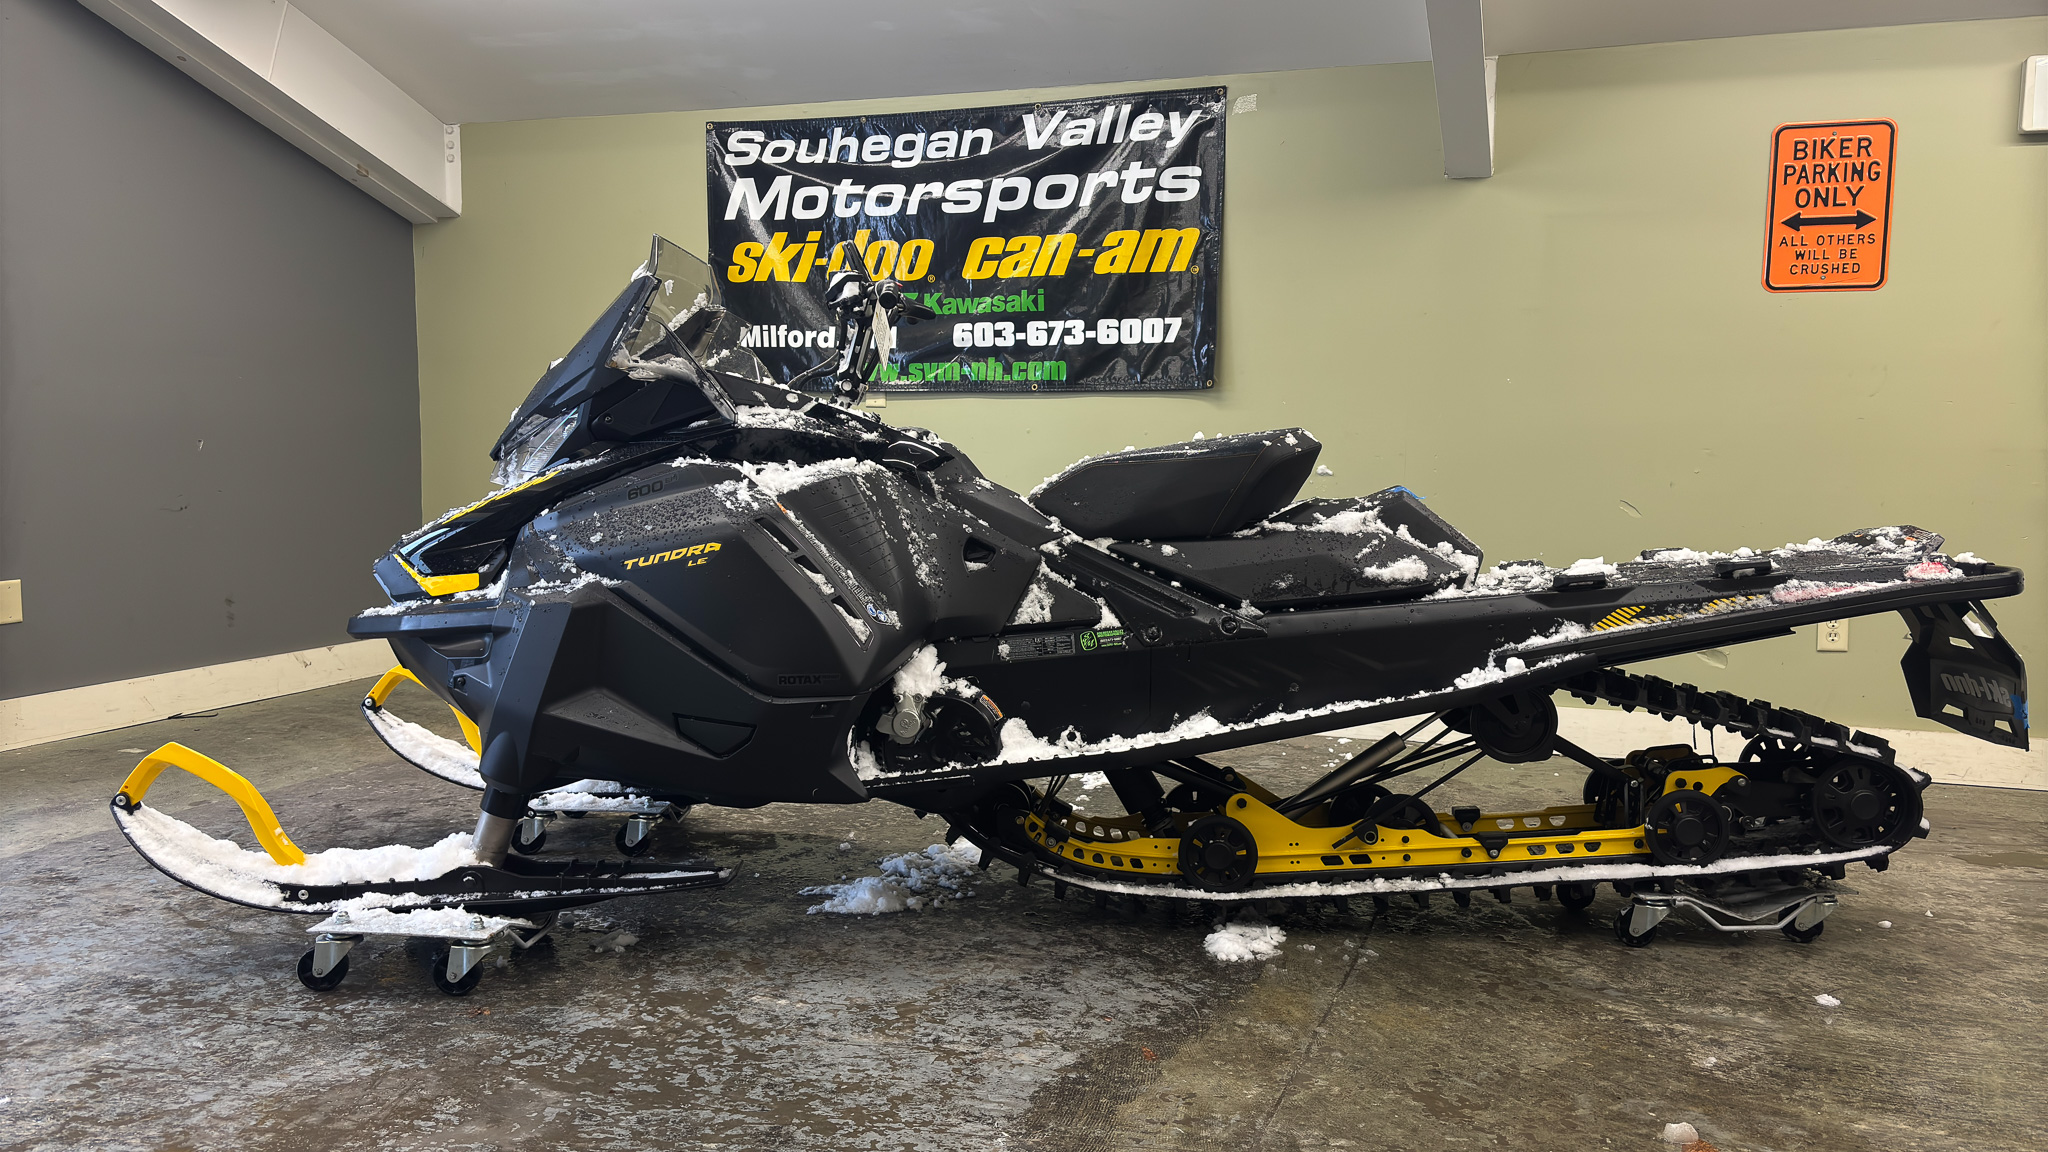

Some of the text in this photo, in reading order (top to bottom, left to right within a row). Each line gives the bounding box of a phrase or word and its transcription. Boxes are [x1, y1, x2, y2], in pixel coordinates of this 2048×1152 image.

[724, 104, 1204, 169] Souhegan Valley
[1793, 137, 1873, 161] BIKER
[1783, 160, 1882, 186] PARKING
[723, 161, 1203, 223] Motorsports
[1795, 185, 1865, 209] ONLY
[1779, 233, 1876, 247] ALL OTHERS
[961, 227, 1201, 280] can-am
[1795, 248, 1857, 261] WILL BE
[1789, 262, 1861, 275] CRUSHED
[924, 288, 1045, 316] Kawasaki
[952, 317, 1183, 348] 603-673-6007
[864, 357, 1067, 383] w.svm-nh.com
[627, 480, 664, 501] 600
[623, 541, 722, 570] TUNDRA
[687, 557, 708, 567] LE
[778, 675, 822, 685] ROTAX
